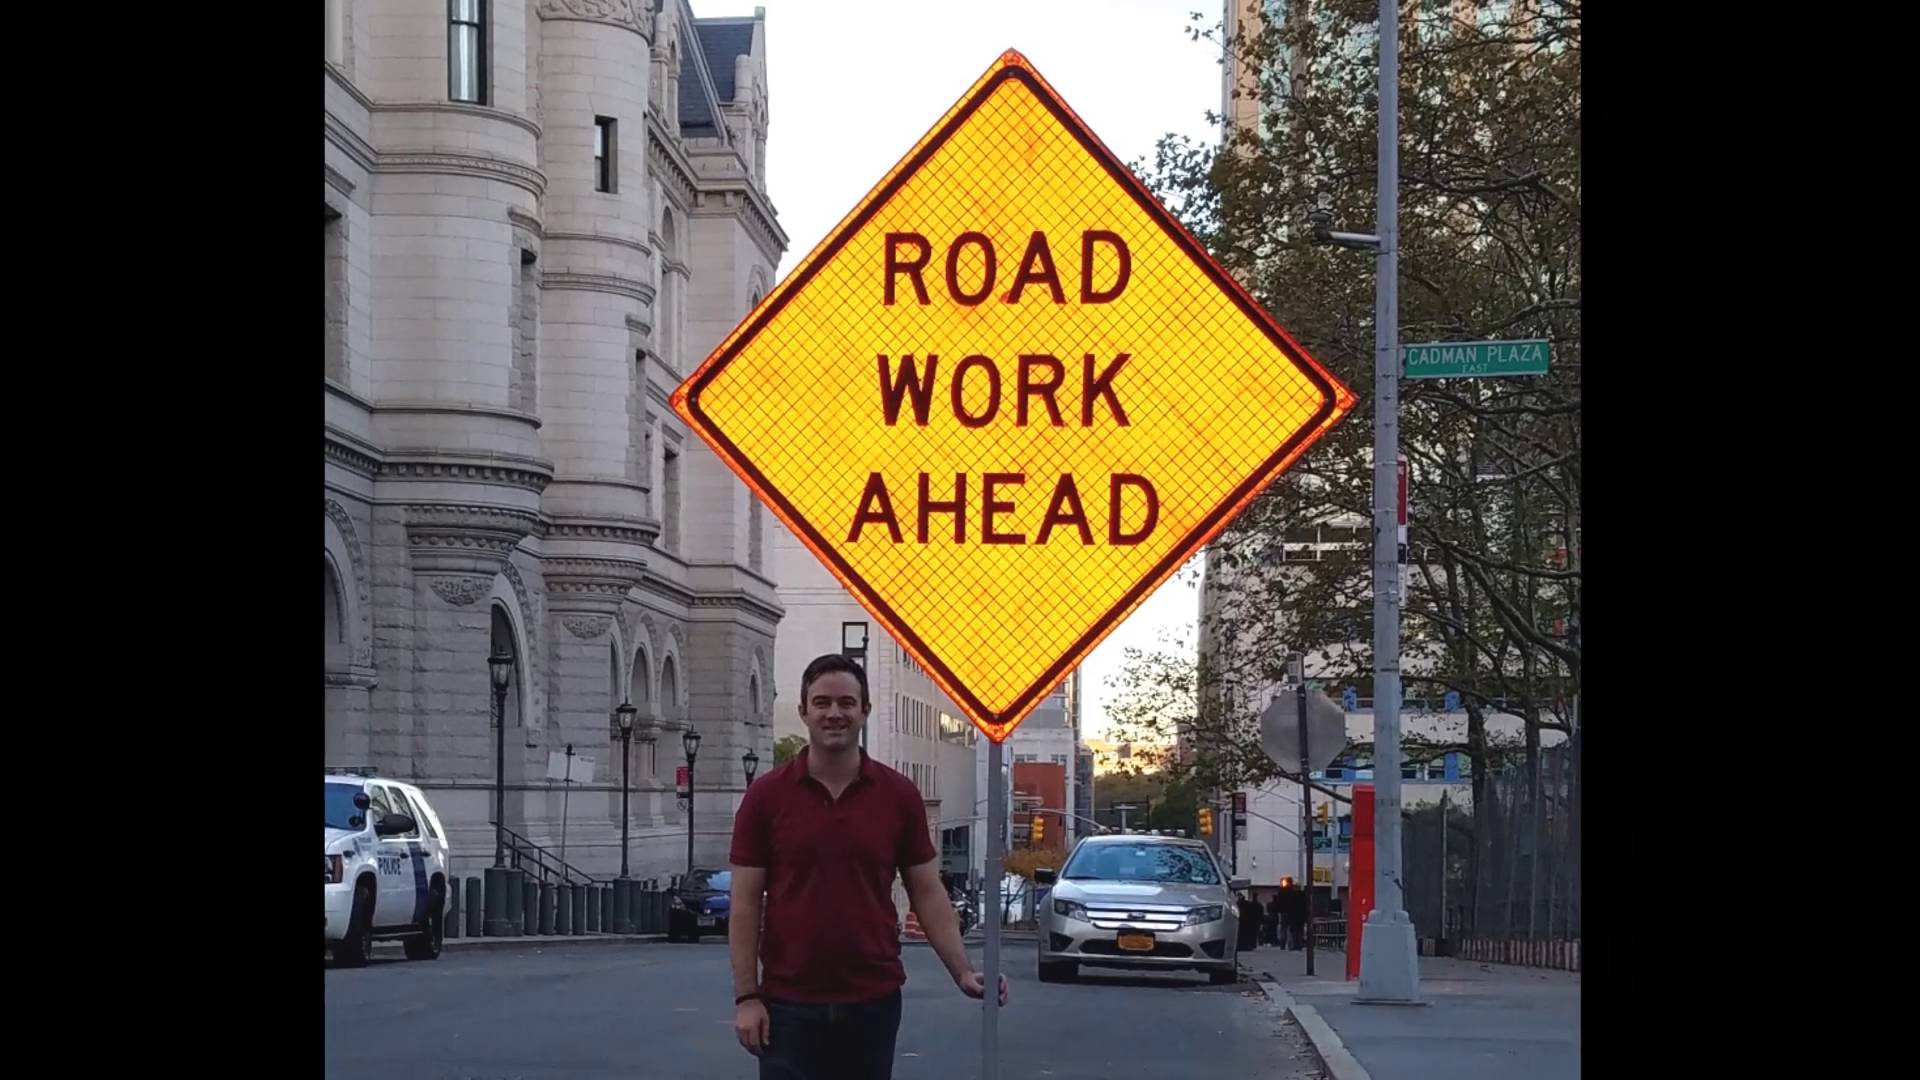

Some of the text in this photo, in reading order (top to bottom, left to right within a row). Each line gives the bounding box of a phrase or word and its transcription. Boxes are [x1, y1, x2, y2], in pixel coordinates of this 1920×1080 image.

[882, 231, 1131, 306] ROAD
[1409, 345, 1542, 365] CADMAN PLAZA
[1462, 363, 1488, 373] EAST
[877, 353, 1132, 428] WORK
[846, 472, 1159, 545] AHEAD
[378, 857, 401, 875] POLICE
